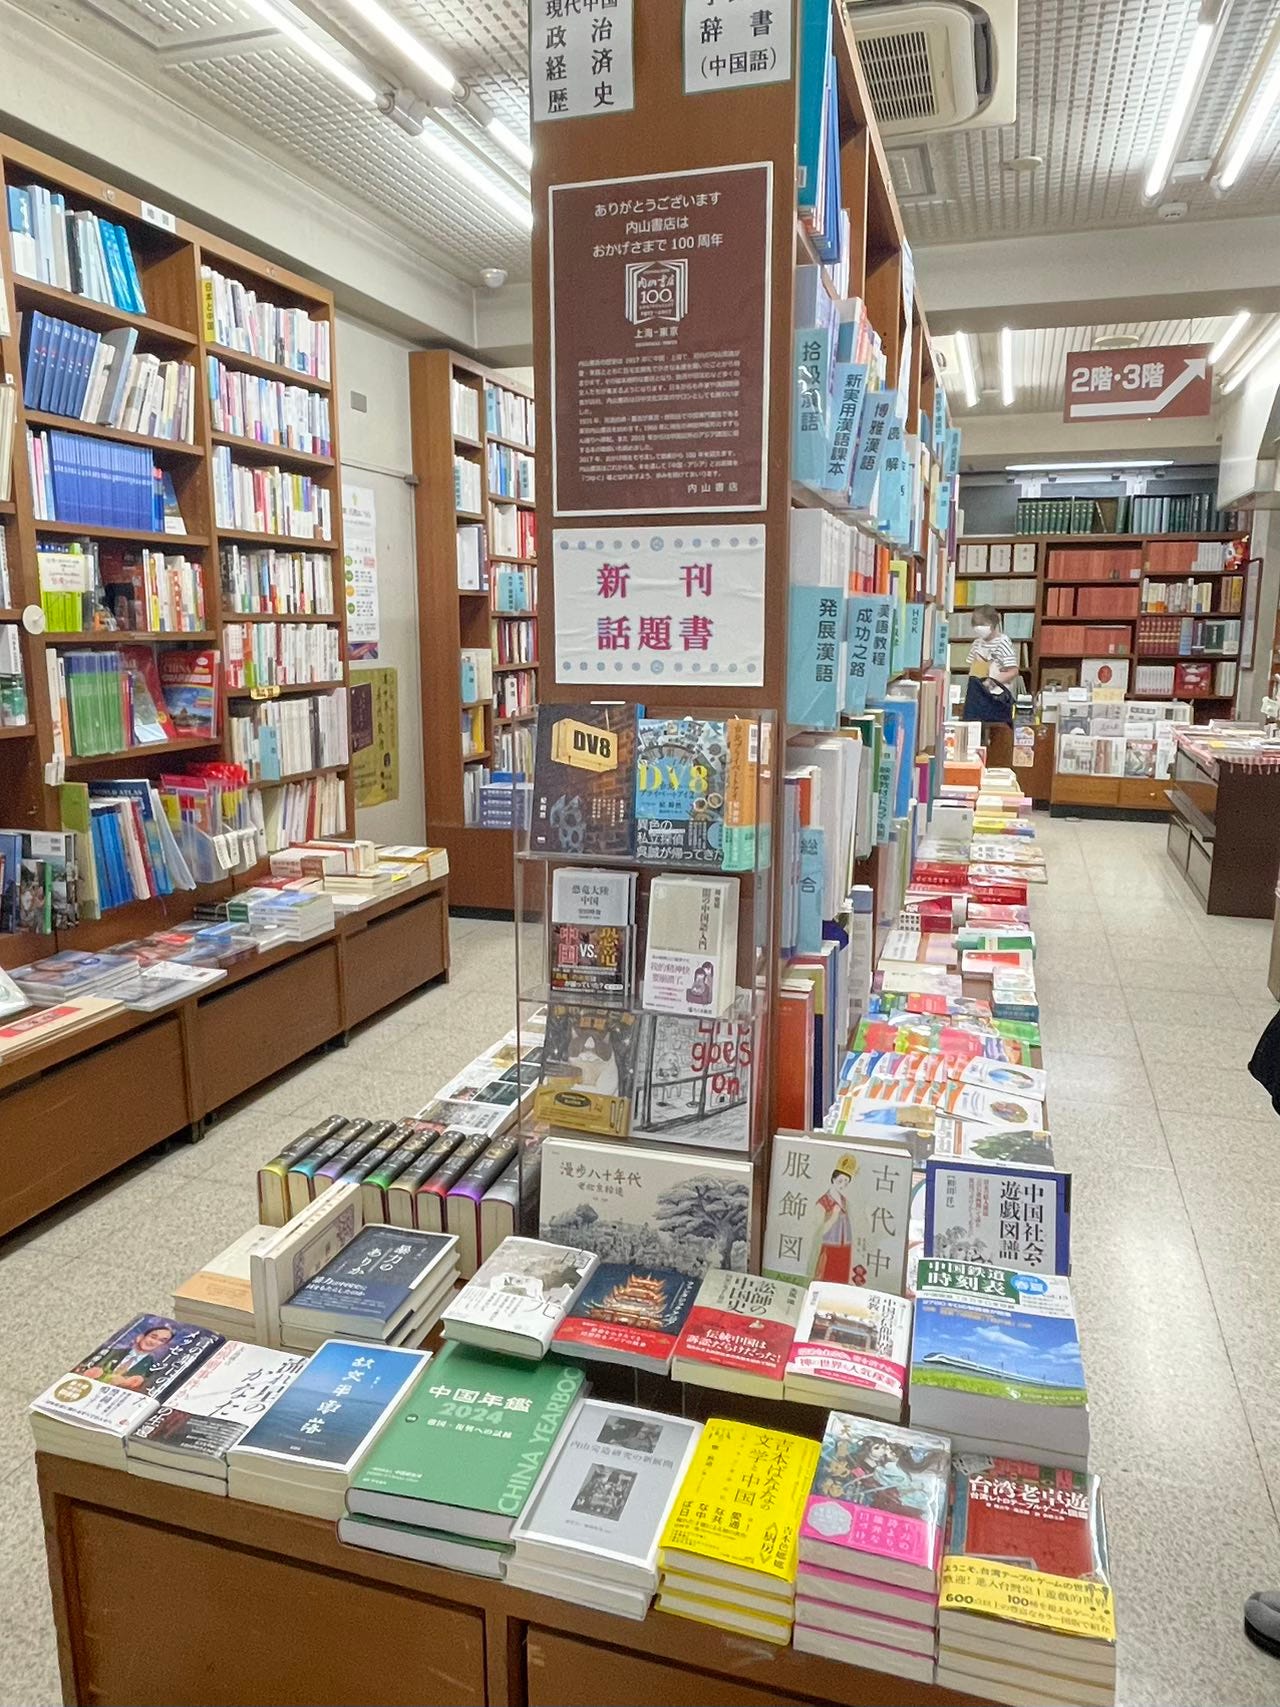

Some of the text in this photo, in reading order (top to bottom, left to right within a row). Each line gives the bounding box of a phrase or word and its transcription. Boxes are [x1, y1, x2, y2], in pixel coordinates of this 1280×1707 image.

[546, 17, 613, 49] 政治
[700, 9, 773, 44] 辞書
[545, 48, 614, 81] 経済
[701, 47, 777, 79] (中国語)
[547, 81, 615, 114] 歴史
[594, 191, 722, 217] ありがとうございます
[625, 215, 690, 235] 内山書店は
[592, 233, 724, 258] おかげさまで 100 周年
[827, 373, 863, 476] 新実用漢語課本
[860, 402, 889, 471] 博雅漢語
[597, 563, 713, 598] 新刊
[597, 615, 713, 651] 話題書
[815, 598, 837, 683] 発展漢語
[850, 607, 873, 678] 成功之路
[573, 729, 611, 759] DV8
[639, 766, 709, 793] DV8
[579, 943, 598, 959] VS.
[691, 1040, 752, 1072] goes
[429, 1385, 533, 1413] 中国年鑑
[437, 1402, 504, 1425] 2024
[498, 1450, 543, 1513] CHINA
